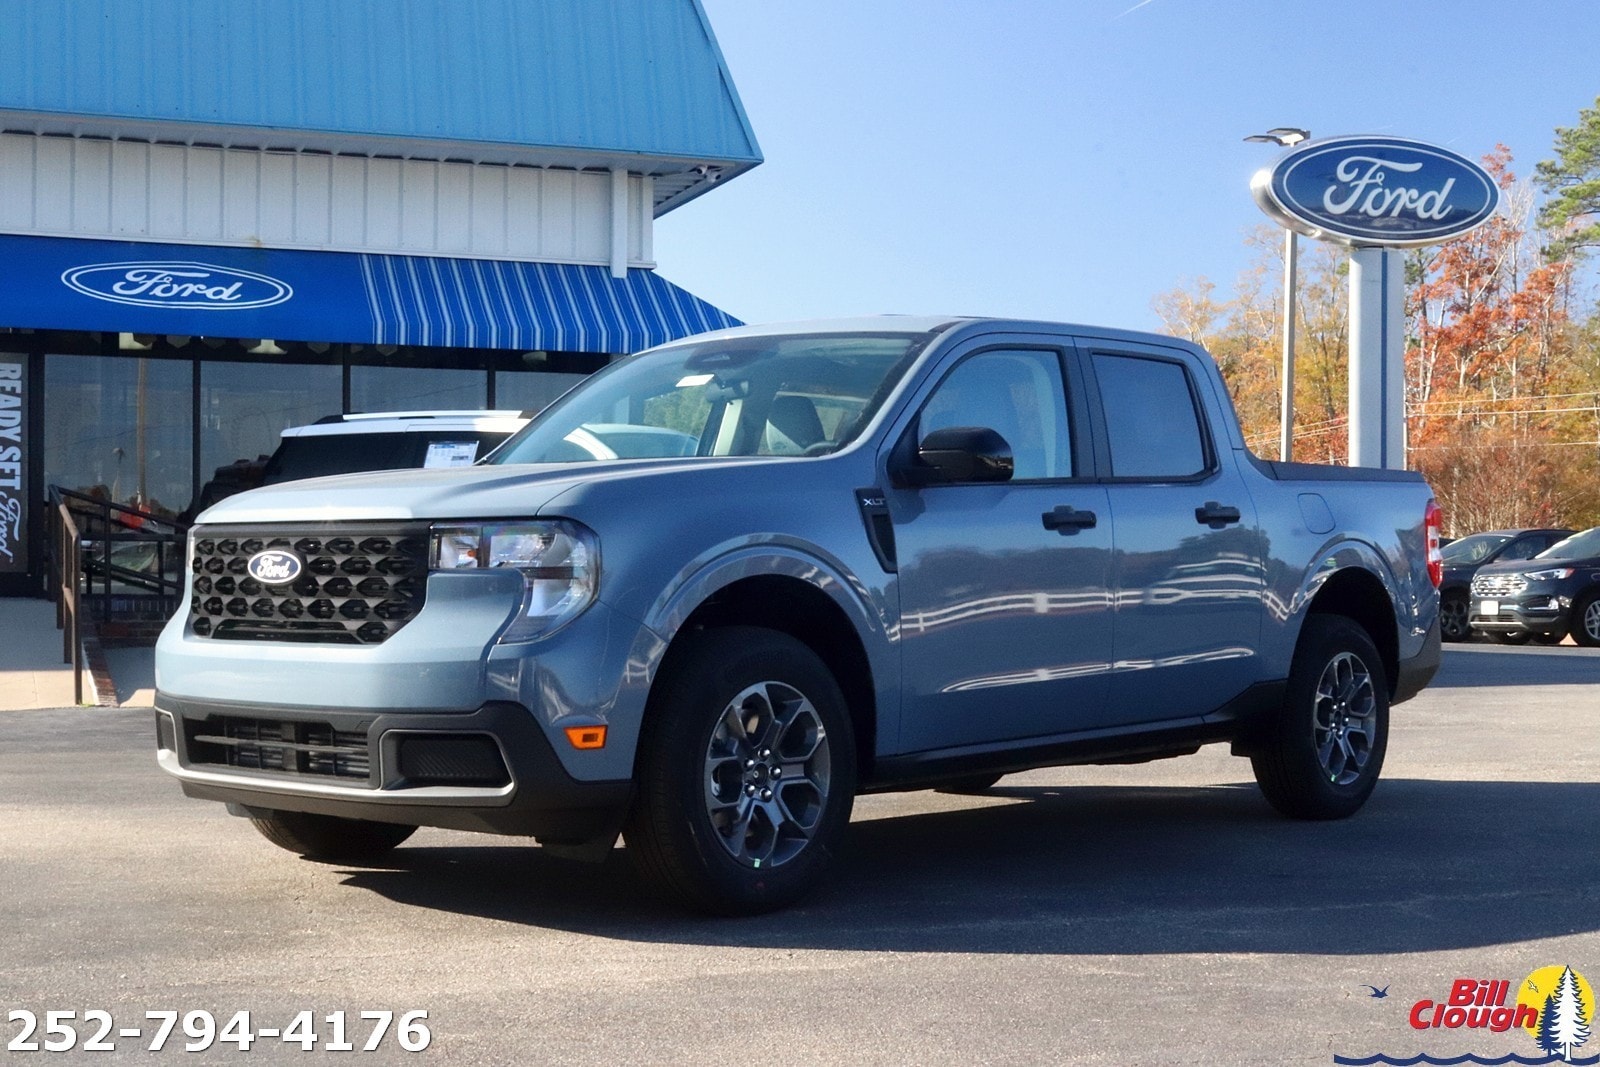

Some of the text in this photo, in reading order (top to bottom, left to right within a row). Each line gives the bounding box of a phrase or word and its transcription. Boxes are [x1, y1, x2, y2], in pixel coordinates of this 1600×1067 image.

[1322, 155, 1456, 220] Ford
[112, 268, 243, 301] Ford
[0, 363, 21, 442] READY
[0, 446, 21, 490] SET
[863, 498, 885, 507] XLT
[256, 554, 291, 578] Ford
